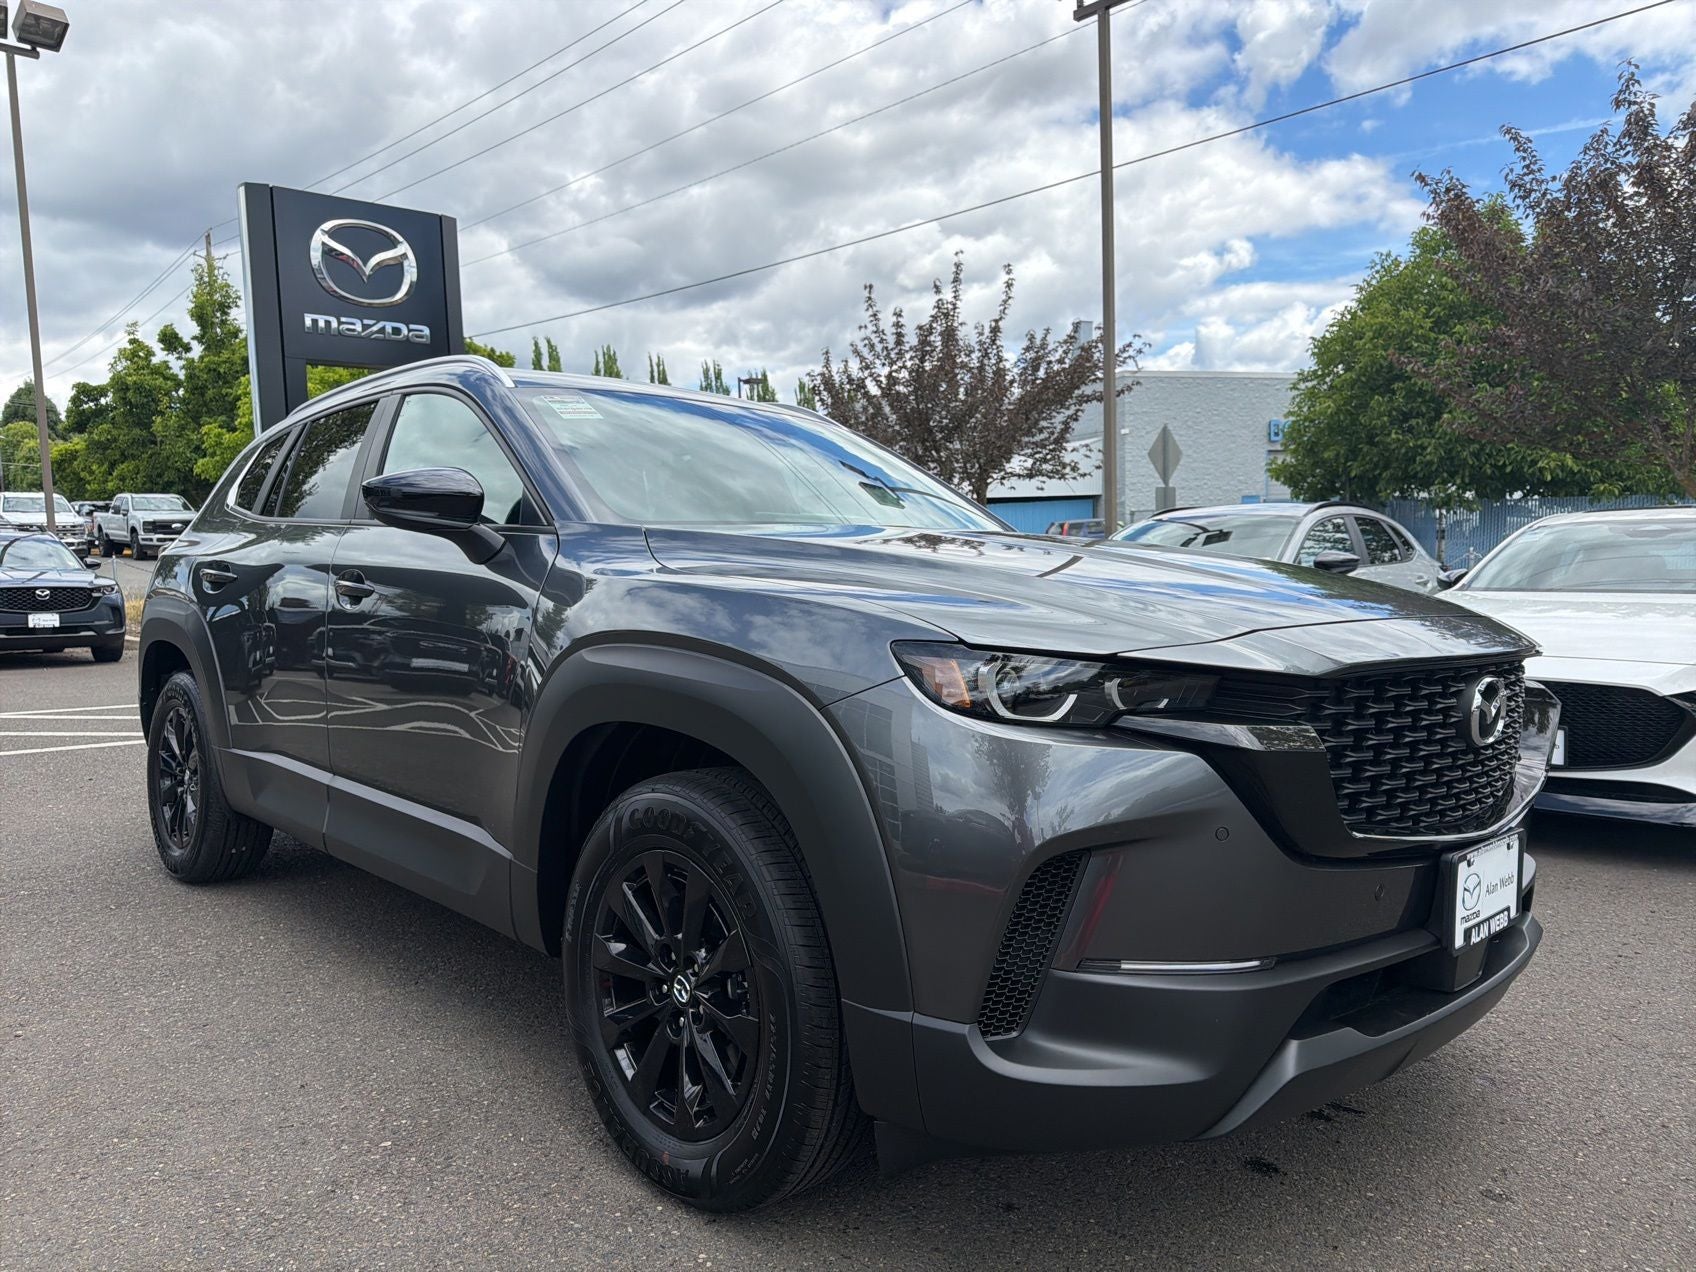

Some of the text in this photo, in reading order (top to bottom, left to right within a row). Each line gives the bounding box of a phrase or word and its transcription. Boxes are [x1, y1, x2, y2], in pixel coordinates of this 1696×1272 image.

[303, 313, 431, 344] mazda
[1485, 872, 1514, 897] Alan Webb
[1470, 911, 1508, 945] ALAN WEBB
